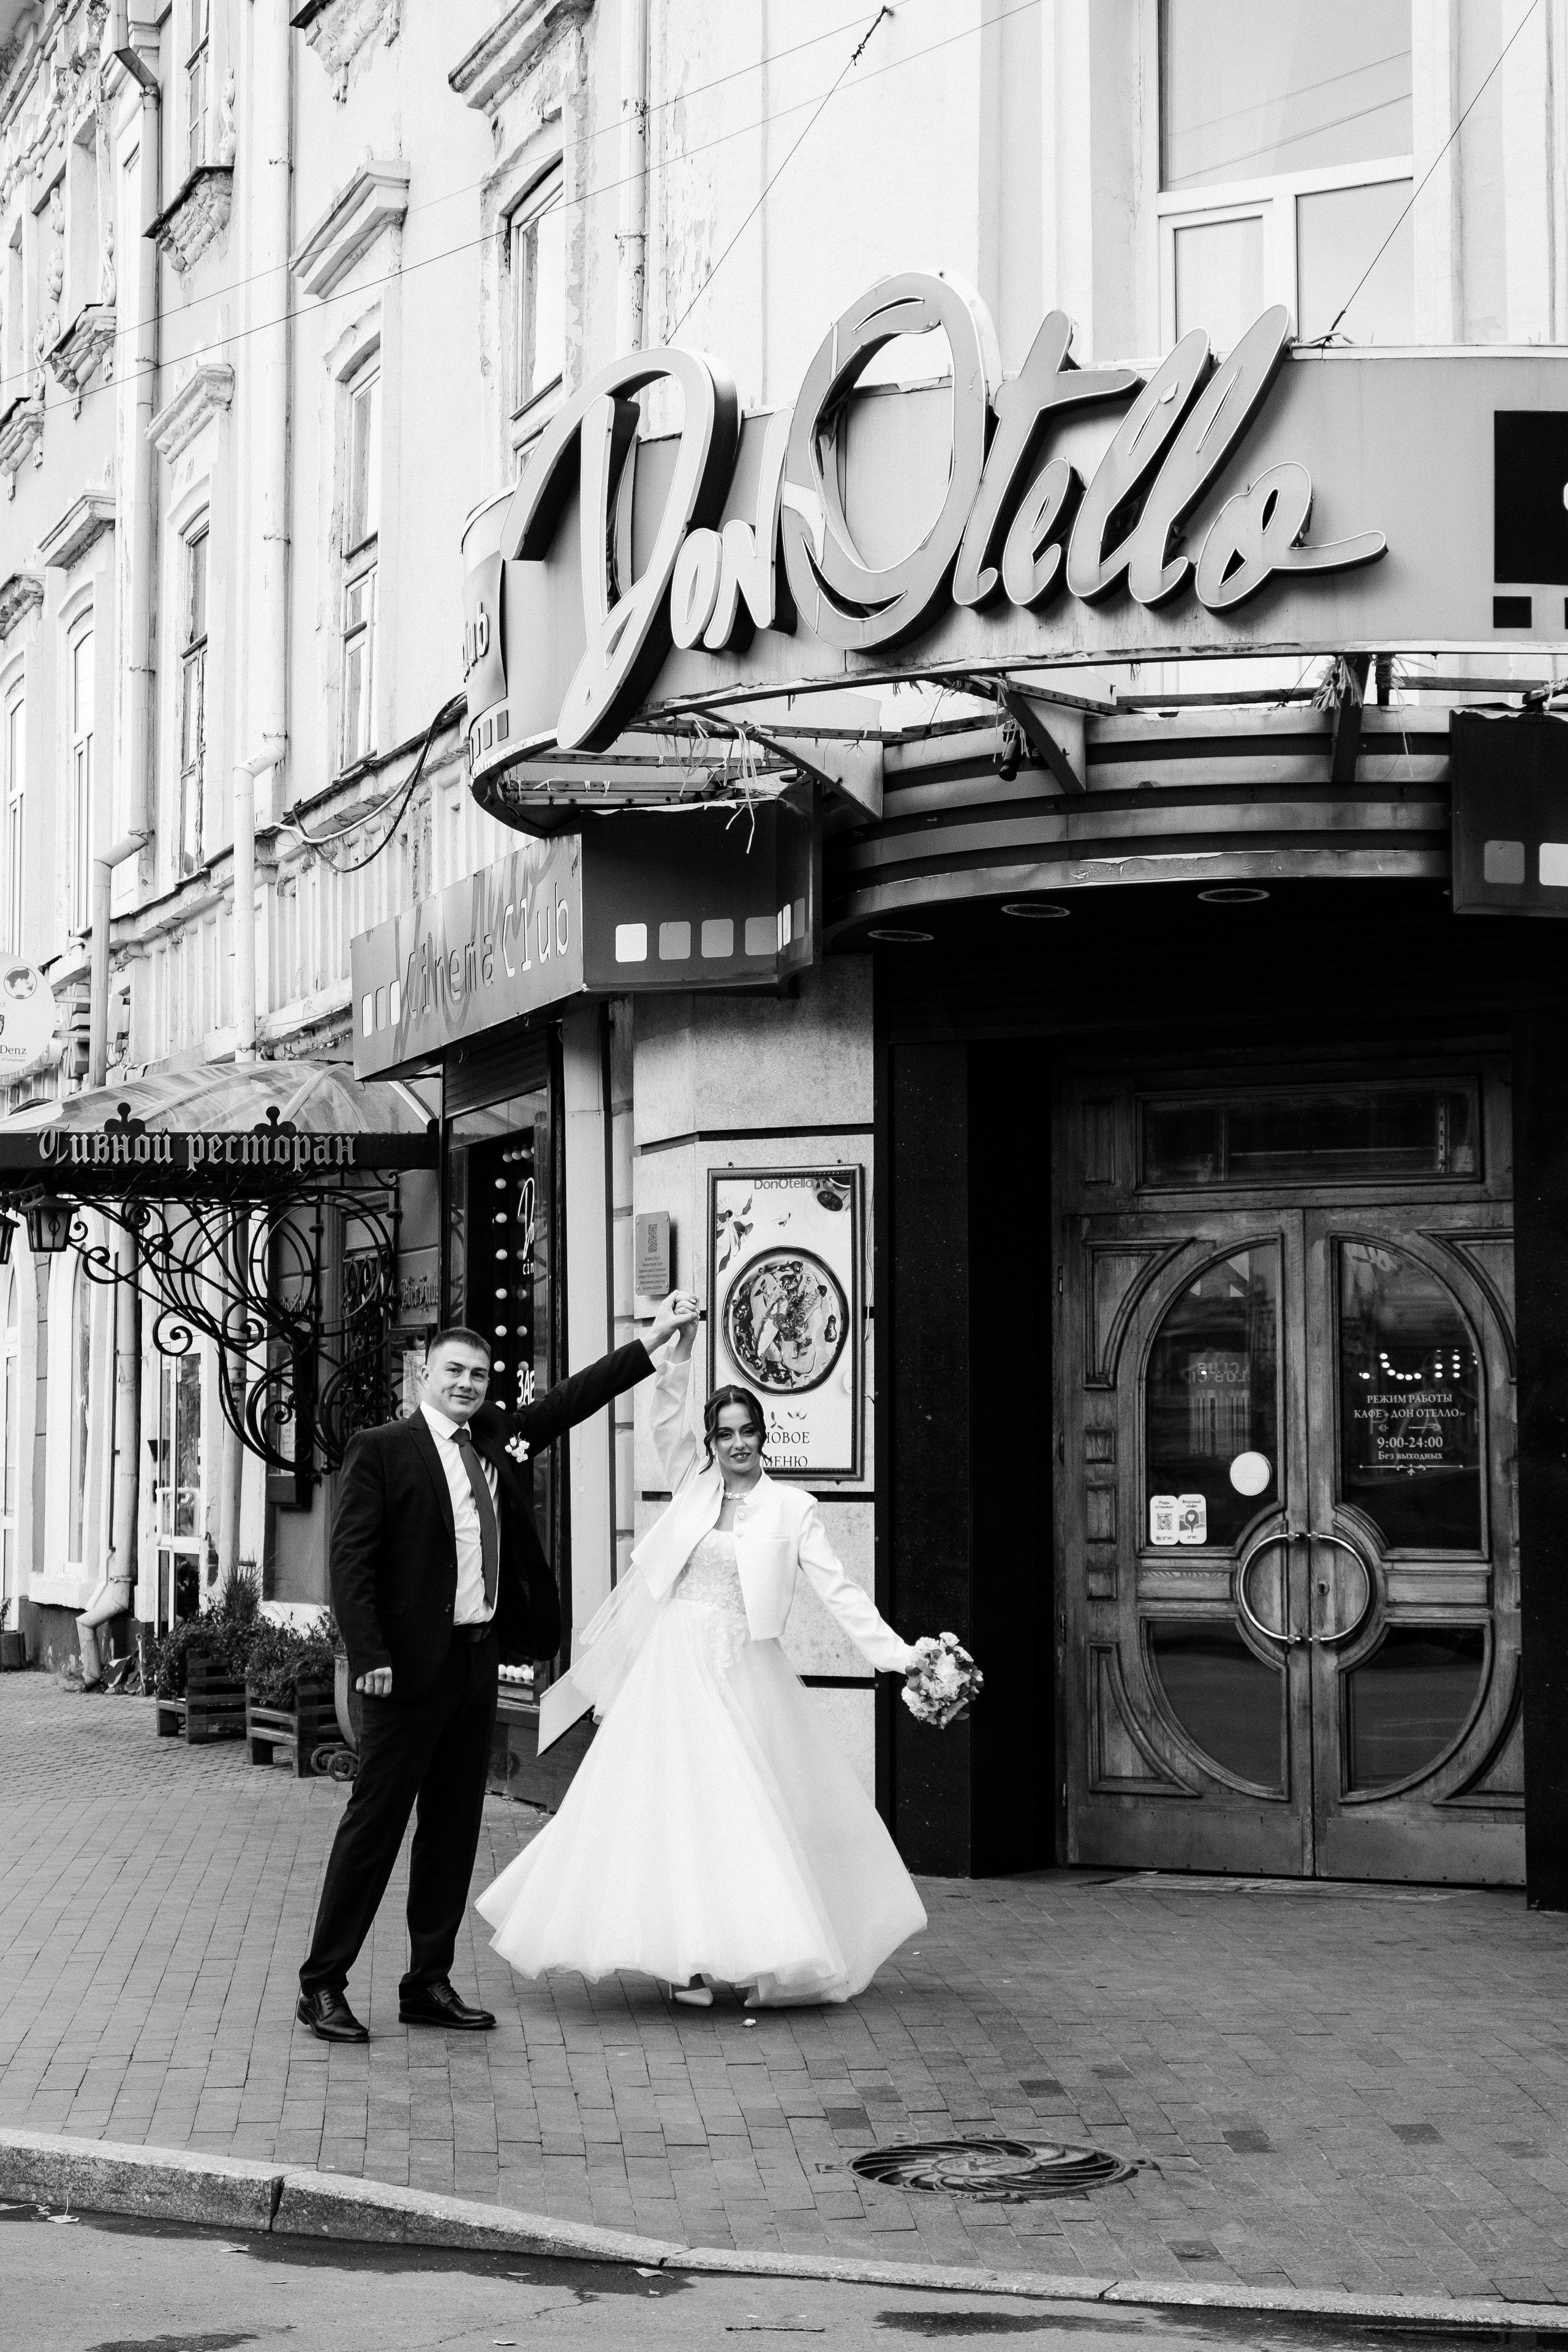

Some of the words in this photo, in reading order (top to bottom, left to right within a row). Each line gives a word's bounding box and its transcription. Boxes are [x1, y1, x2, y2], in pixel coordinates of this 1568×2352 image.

[406, 933, 493, 1020] Cinema
[502, 881, 570, 978] Club
[186, 1134, 356, 1172] ресторан
[1367, 1394, 1407, 1404] РЕЖИМ
[1409, 1394, 1452, 1403] РАБОТЫ
[1354, 1409, 1382, 1419] КАФЕ
[1377, 1436, 1443, 1449] 9:00-24:00
[1378, 1451, 1394, 1460] Без
